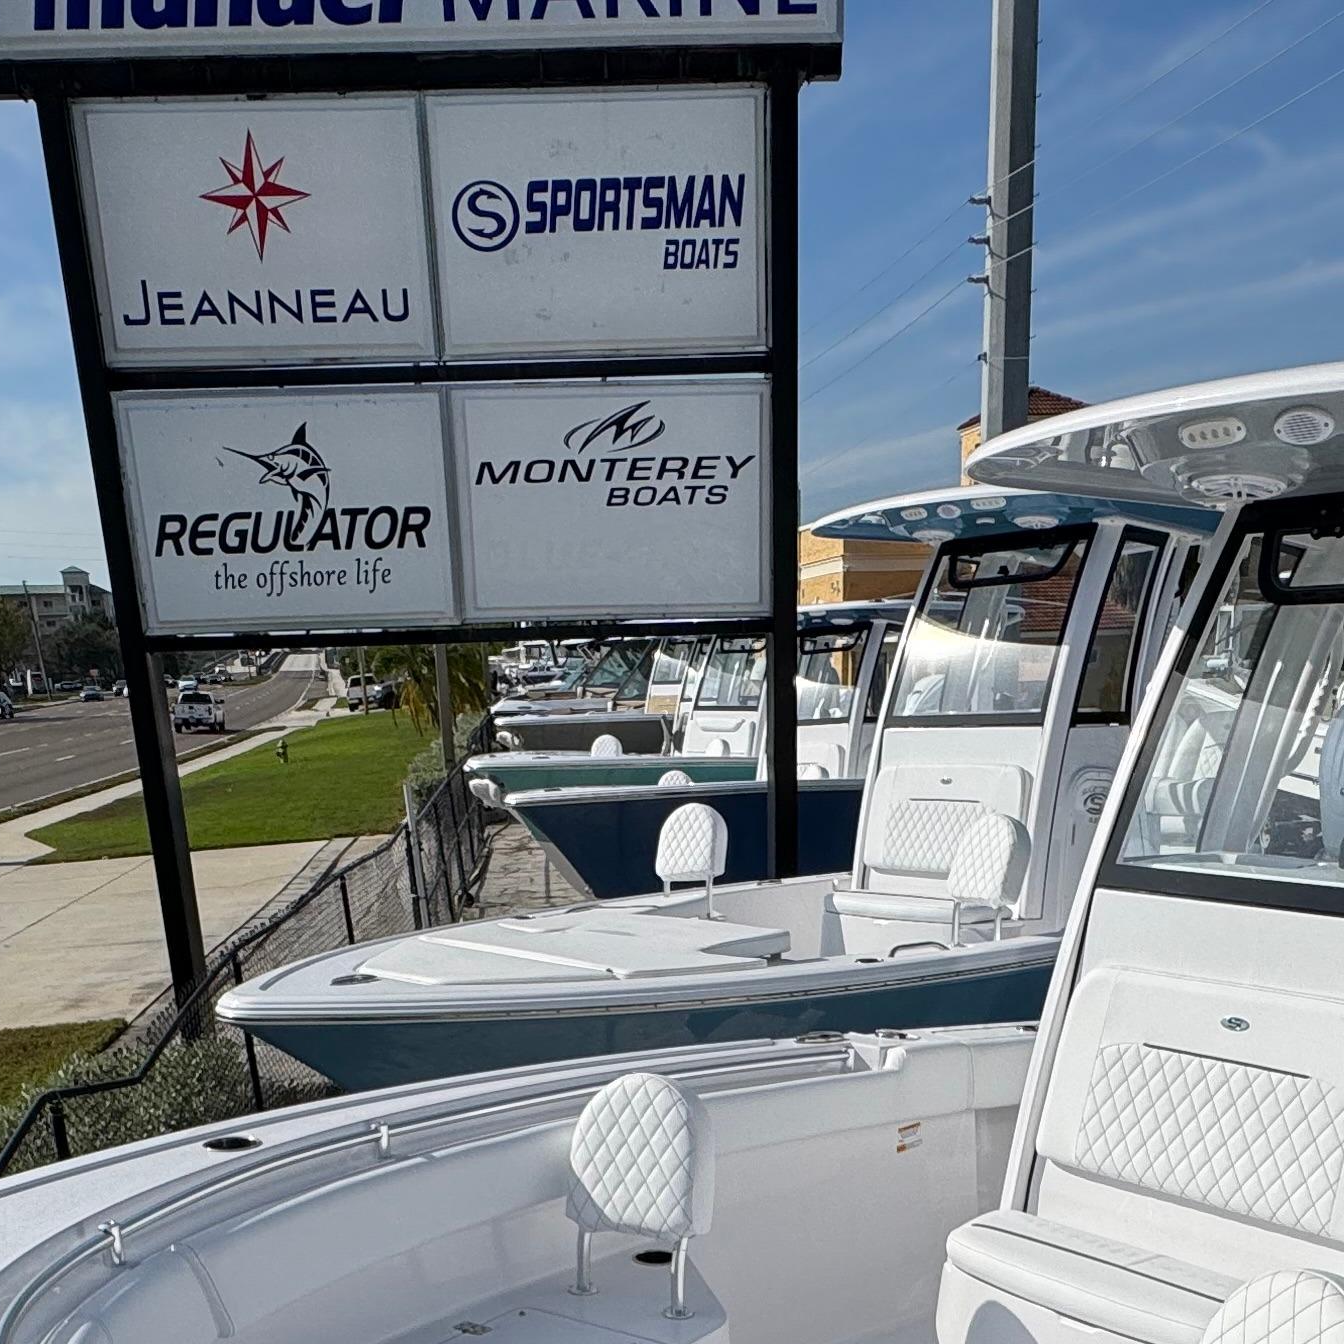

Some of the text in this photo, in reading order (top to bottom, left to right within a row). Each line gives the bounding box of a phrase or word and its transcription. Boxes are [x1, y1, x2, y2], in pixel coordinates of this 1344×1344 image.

[525, 173, 746, 235] SPORTSMAN
[663, 237, 741, 271] BOATS
[123, 279, 411, 327] JEANNEAU
[475, 454, 756, 486] MONTEREY
[605, 484, 730, 508] BOATS
[154, 505, 432, 558] REGULATOR
[214, 556, 392, 598] the offshore life
